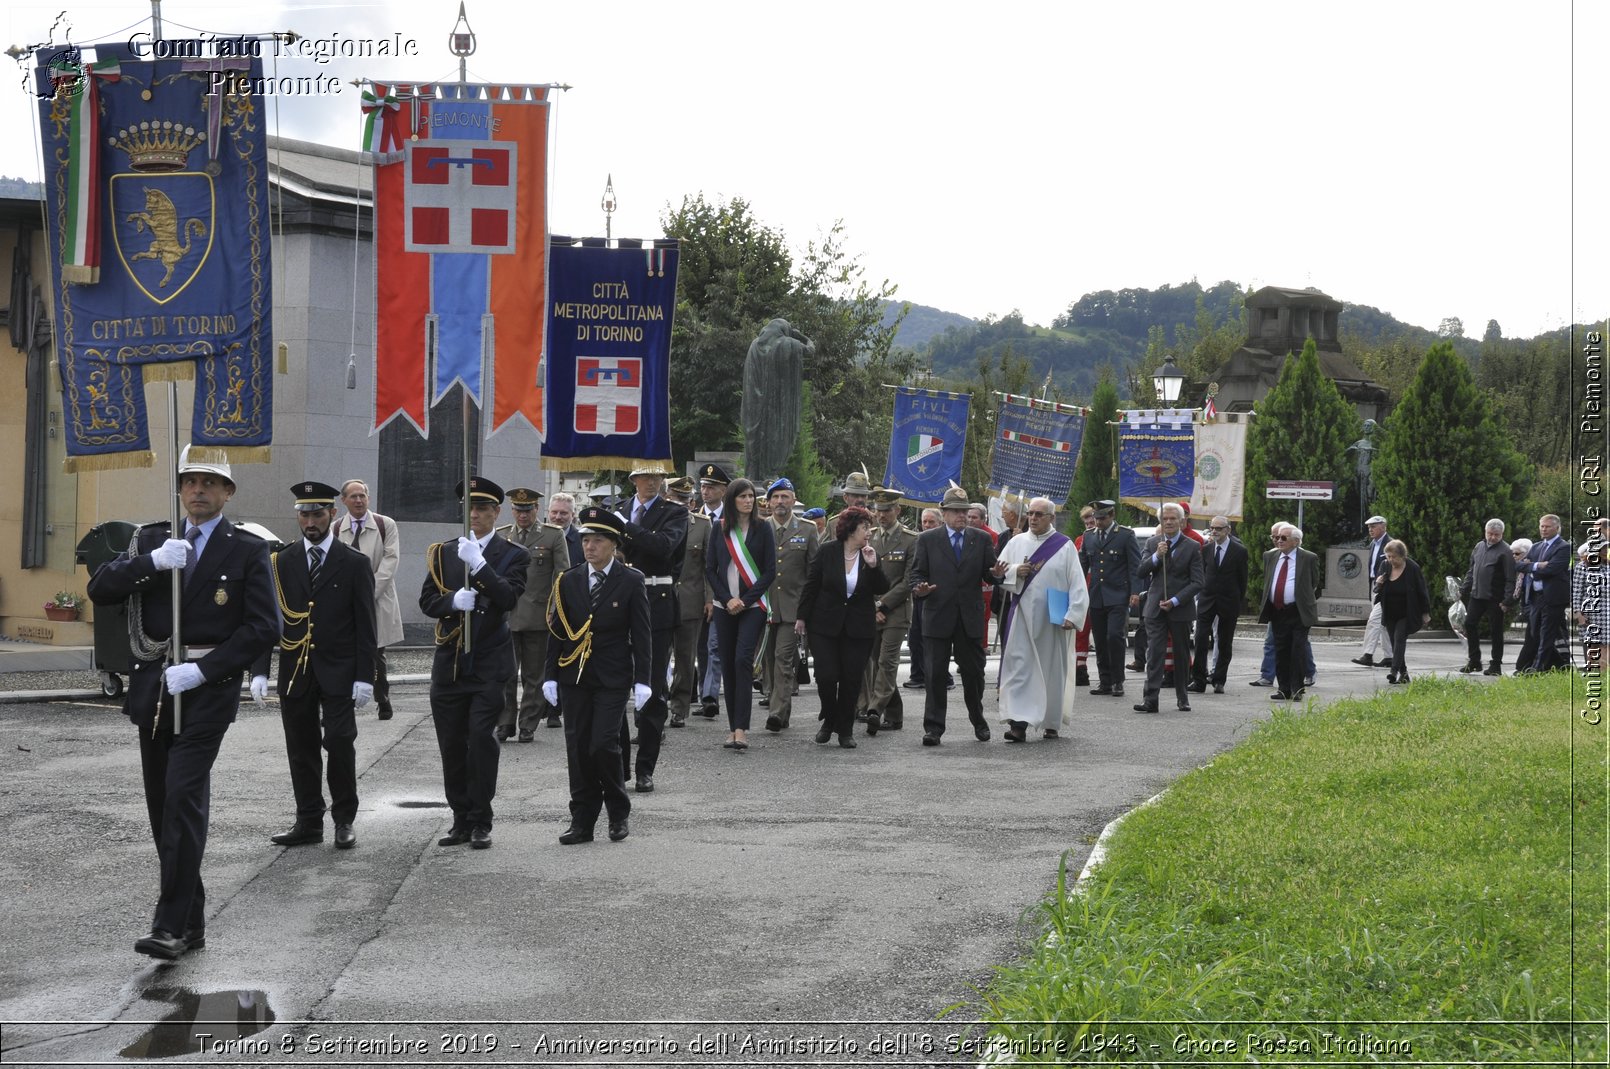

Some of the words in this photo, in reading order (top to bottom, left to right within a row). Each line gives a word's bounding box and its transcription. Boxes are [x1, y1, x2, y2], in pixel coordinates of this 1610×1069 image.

[420, 112, 501, 132] PIEMONTE
[593, 280, 629, 299] CITTÀ
[554, 302, 664, 321] METROPOLITANA
[152, 316, 167, 336] DI
[173, 314, 236, 336] TORINO
[577, 325, 590, 341] DI
[593, 325, 643, 342] TORINO
[908, 445, 941, 463] AUTONOMI
[1329, 604, 1363, 615] DENTIS
